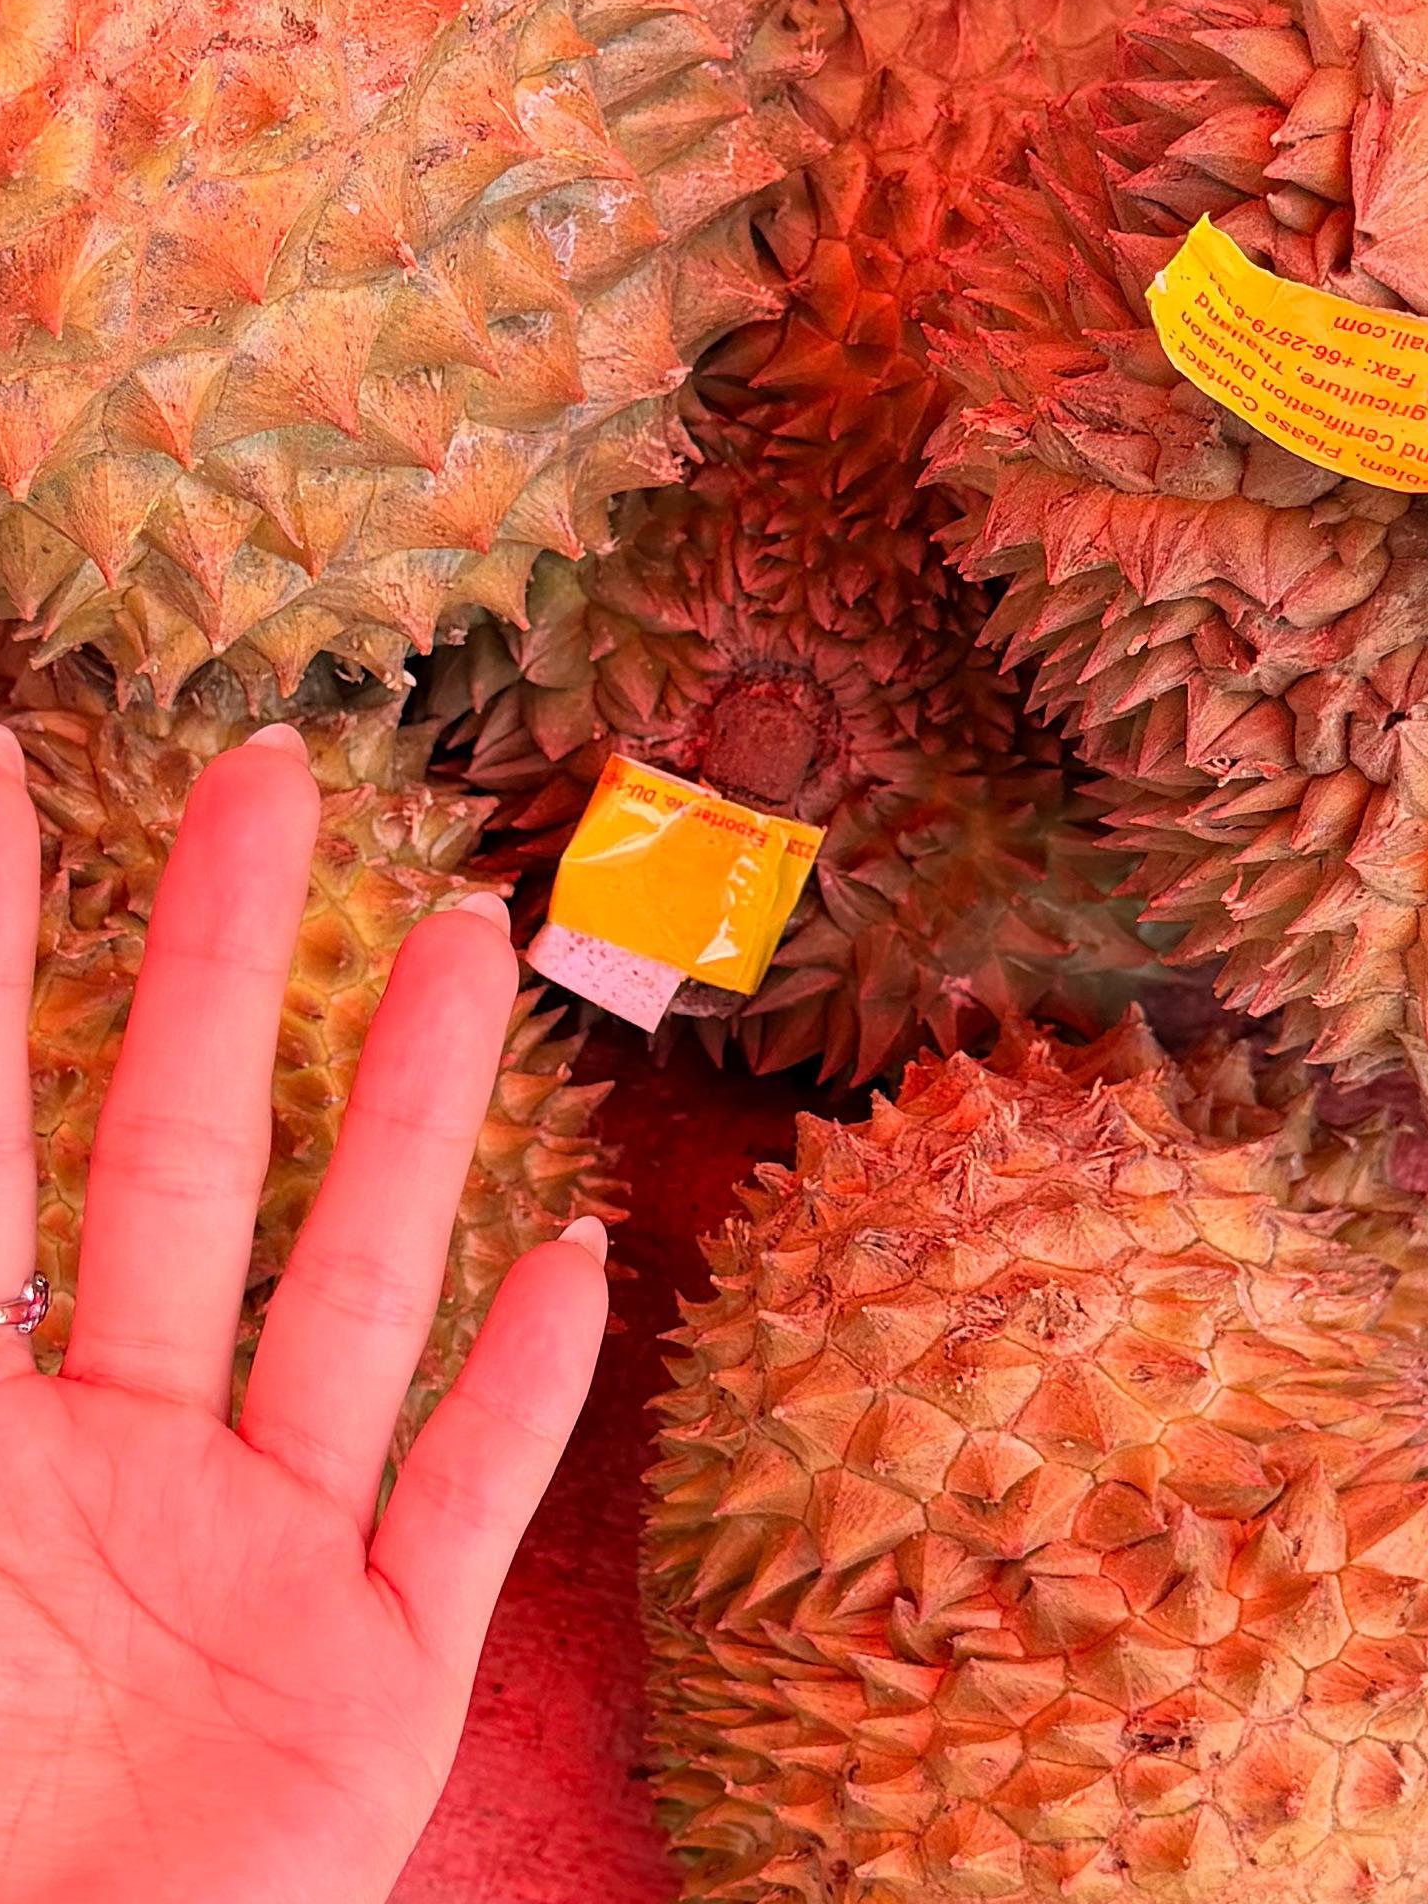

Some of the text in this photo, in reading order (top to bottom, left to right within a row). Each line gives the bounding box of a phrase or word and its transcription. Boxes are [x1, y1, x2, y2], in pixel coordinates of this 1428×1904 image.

[1181, 310, 1258, 381] Division
[1194, 291, 1285, 376] Thailand
[1178, 341, 1259, 413] Contact
[1363, 358, 1416, 389] Fax:
[1261, 377, 1395, 453] Certification
[1265, 411, 1343, 460] Please
